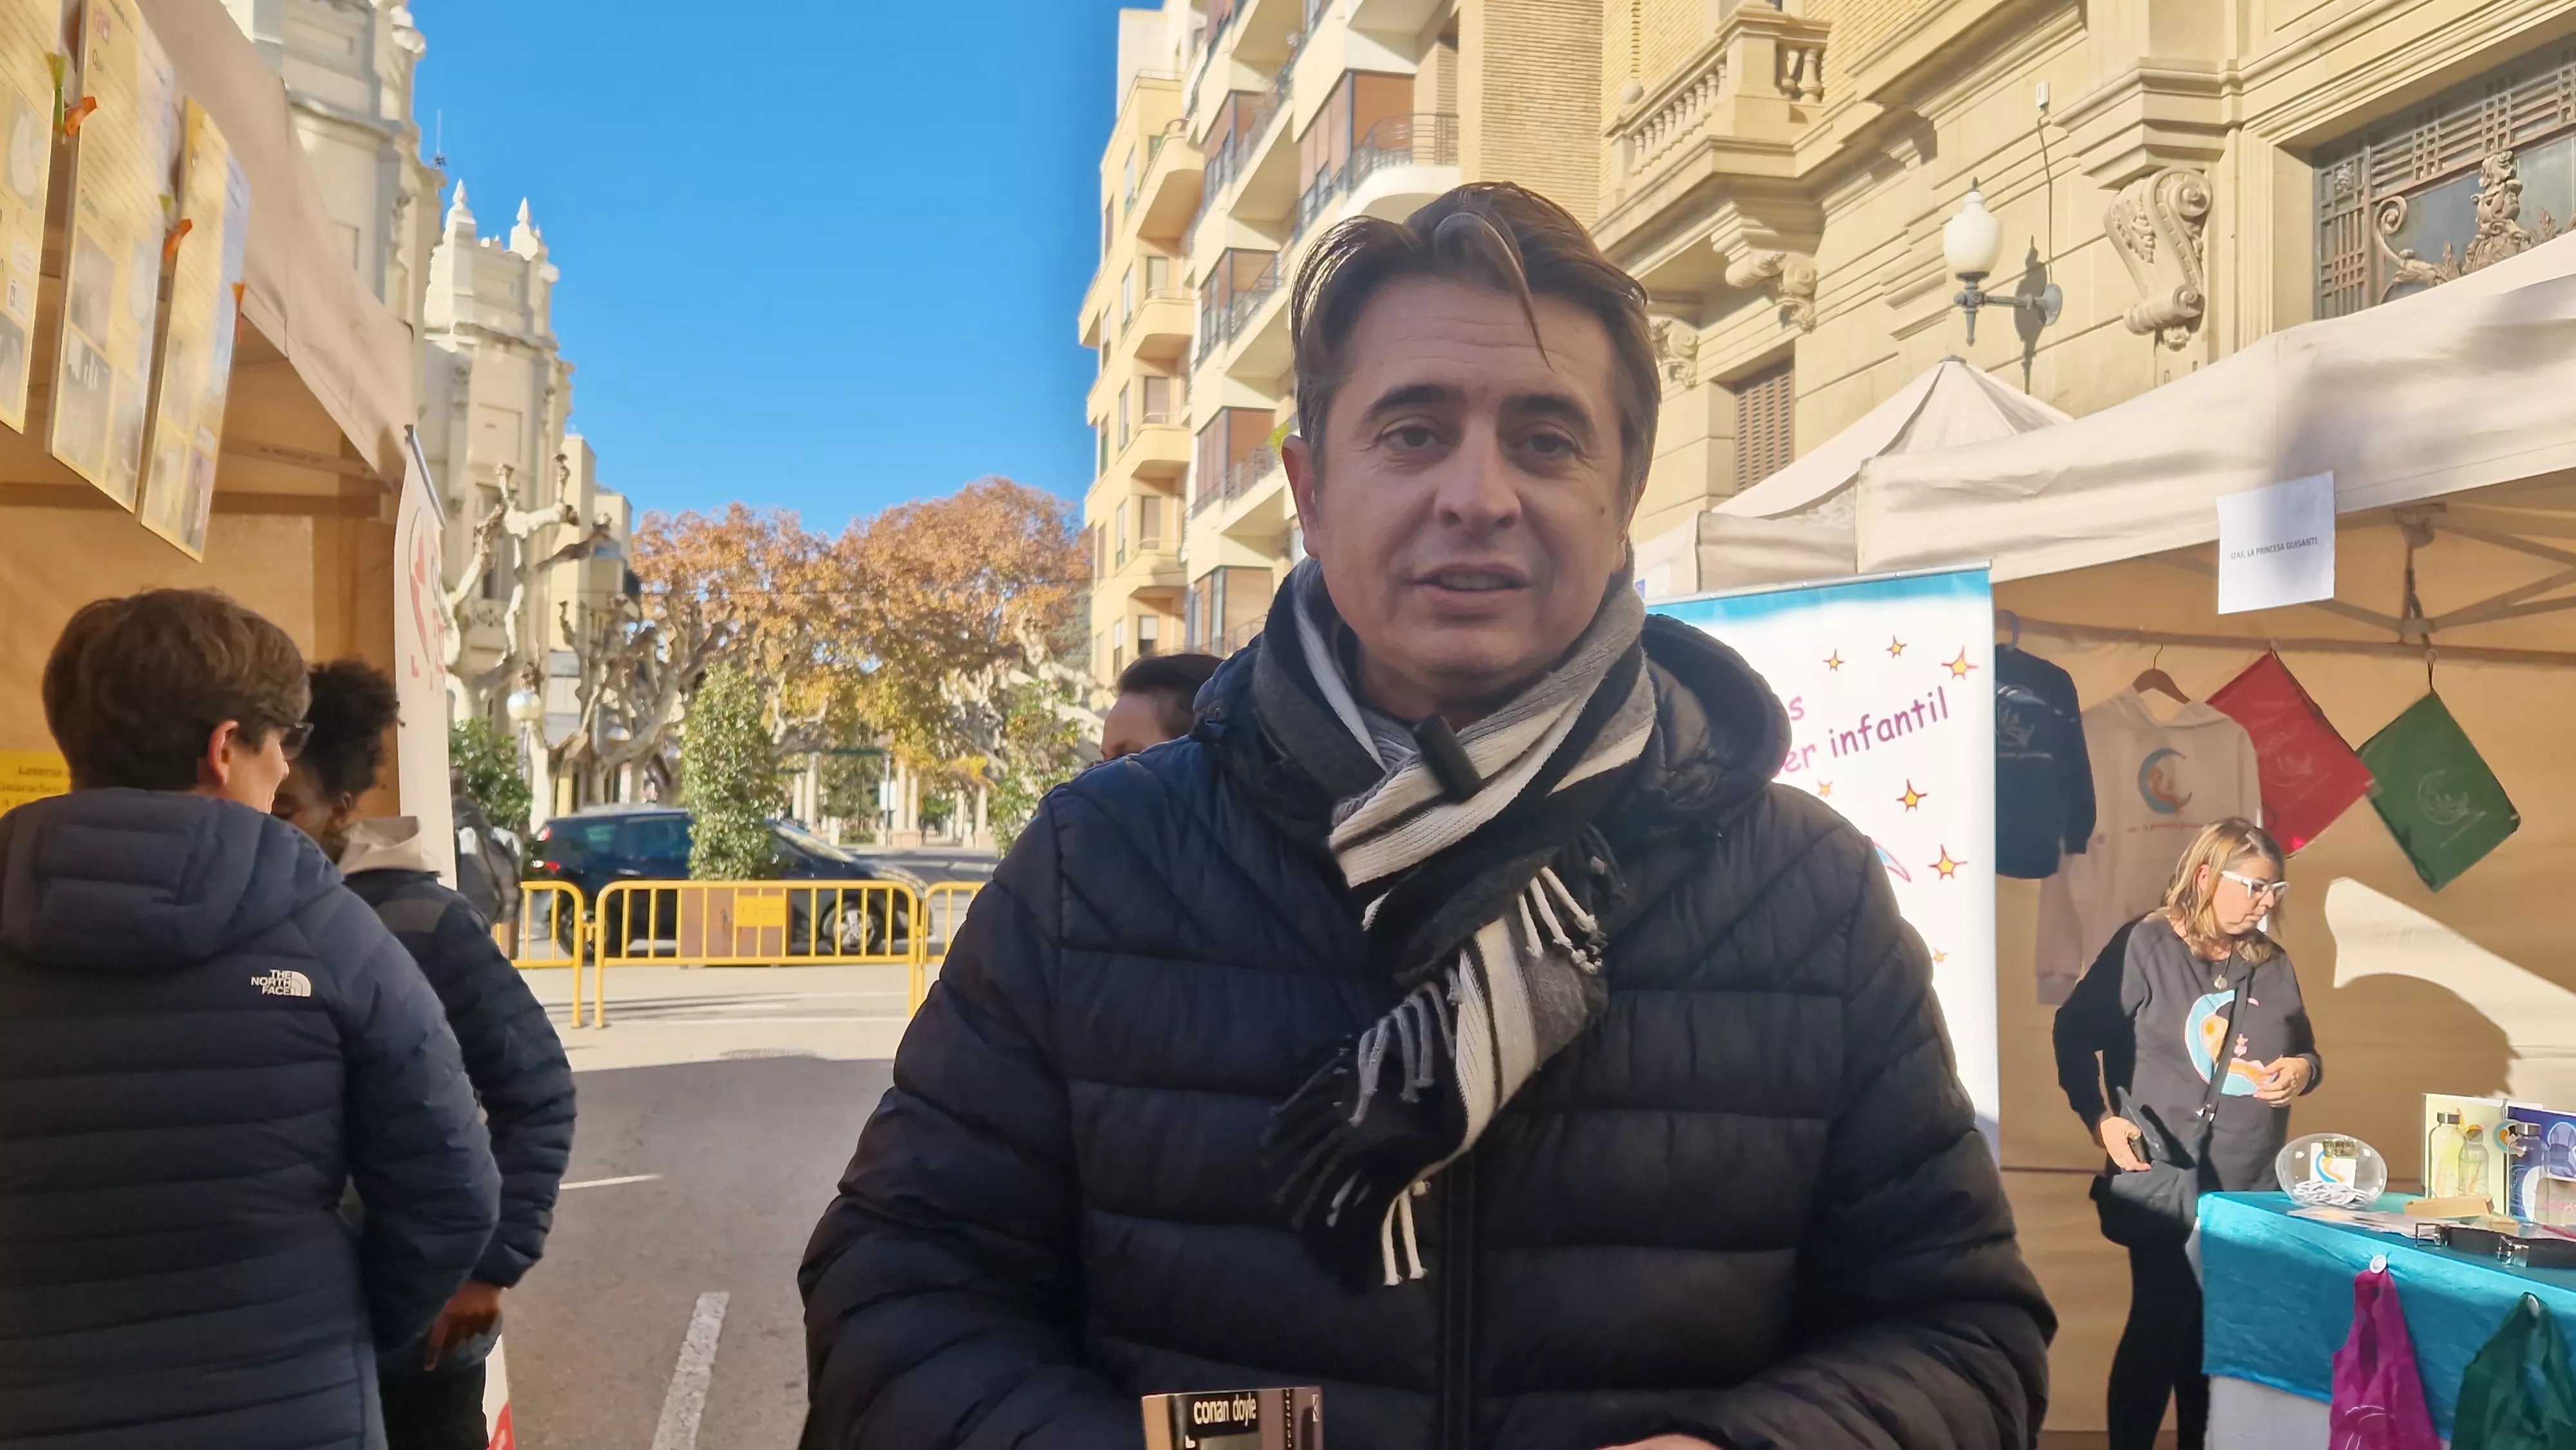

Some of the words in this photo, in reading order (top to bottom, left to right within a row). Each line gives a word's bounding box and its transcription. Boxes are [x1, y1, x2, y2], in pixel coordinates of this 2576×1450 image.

[2248, 548, 2255, 557] LA
[2256, 543, 2284, 556] PRINCESA
[2286, 536, 2318, 550] GUISANTE
[1828, 685, 1948, 758] infantil
[251, 976, 291, 987] NORTH
[270, 969, 292, 979] THE
[261, 986, 291, 995] FACE
[1193, 1400, 1229, 1425] conan
[1233, 1391, 1257, 1427] doyle
